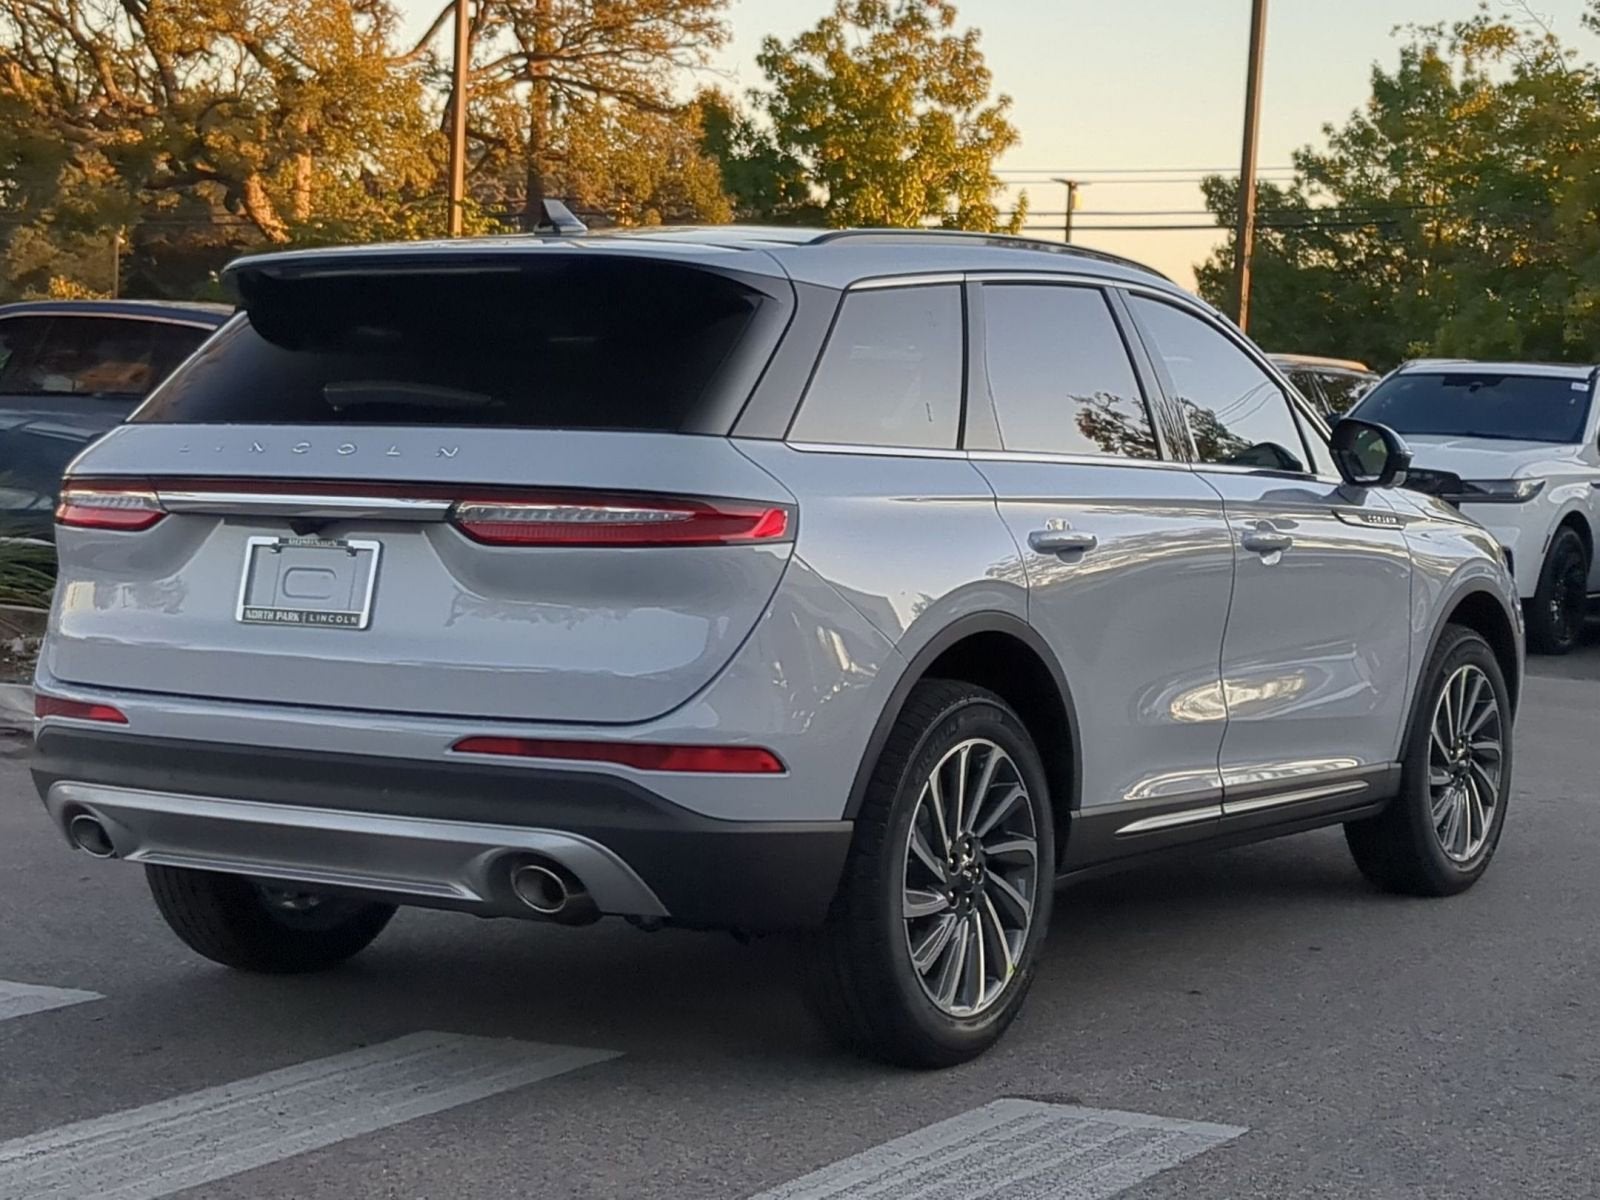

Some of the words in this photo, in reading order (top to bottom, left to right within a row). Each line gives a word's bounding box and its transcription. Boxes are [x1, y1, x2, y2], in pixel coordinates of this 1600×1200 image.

[179, 441, 459, 457] LINCOLN
[245, 609, 274, 620] NORTH
[276, 611, 299, 622] PARK
[310, 614, 358, 624] LINCOLN
